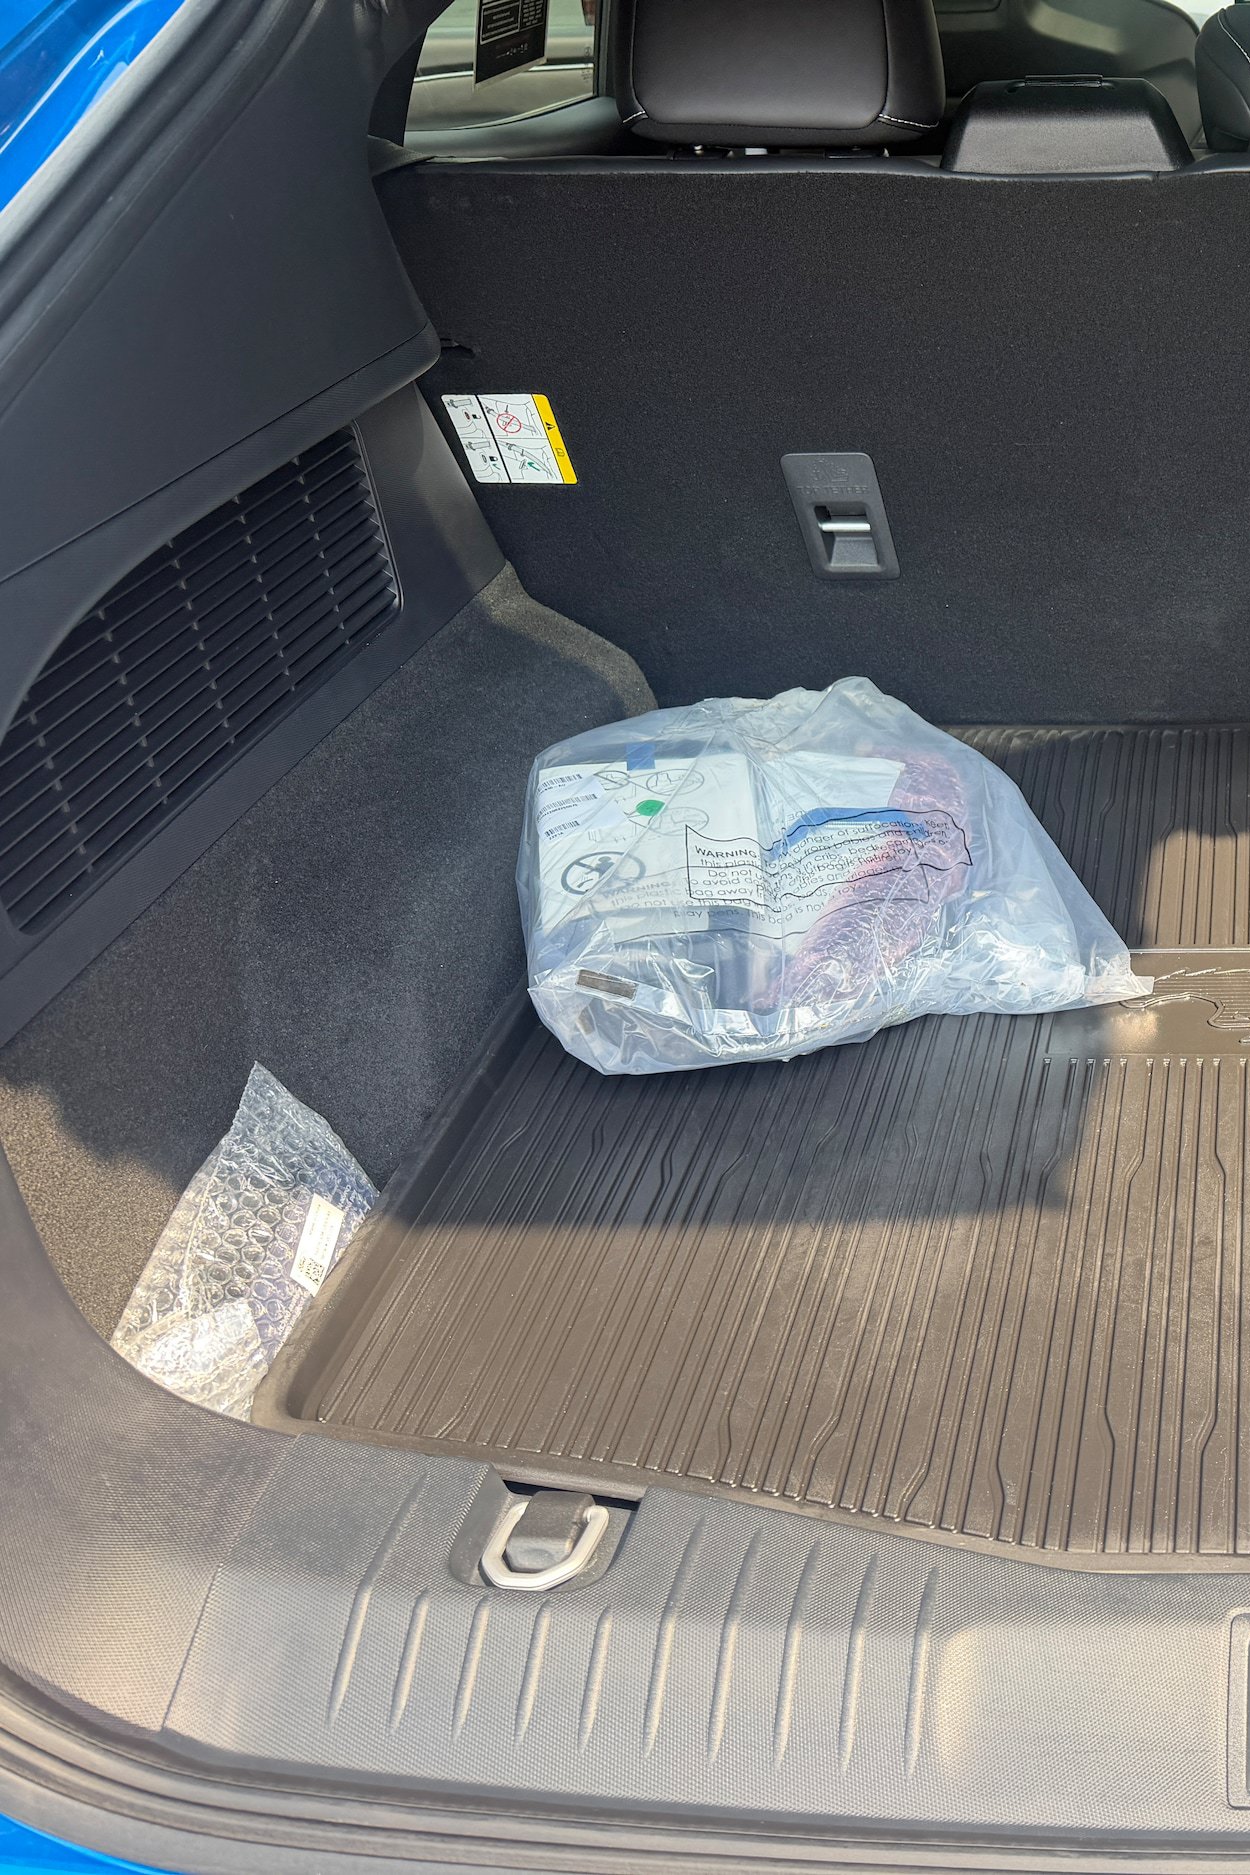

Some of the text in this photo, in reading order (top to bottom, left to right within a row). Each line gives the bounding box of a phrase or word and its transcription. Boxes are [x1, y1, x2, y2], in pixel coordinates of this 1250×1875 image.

[793, 835, 834, 854] danger
[838, 829, 850, 837] of
[708, 869, 727, 878] Do
[731, 869, 752, 877] not
[703, 876, 740, 885] avoid
[717, 887, 753, 896] away
